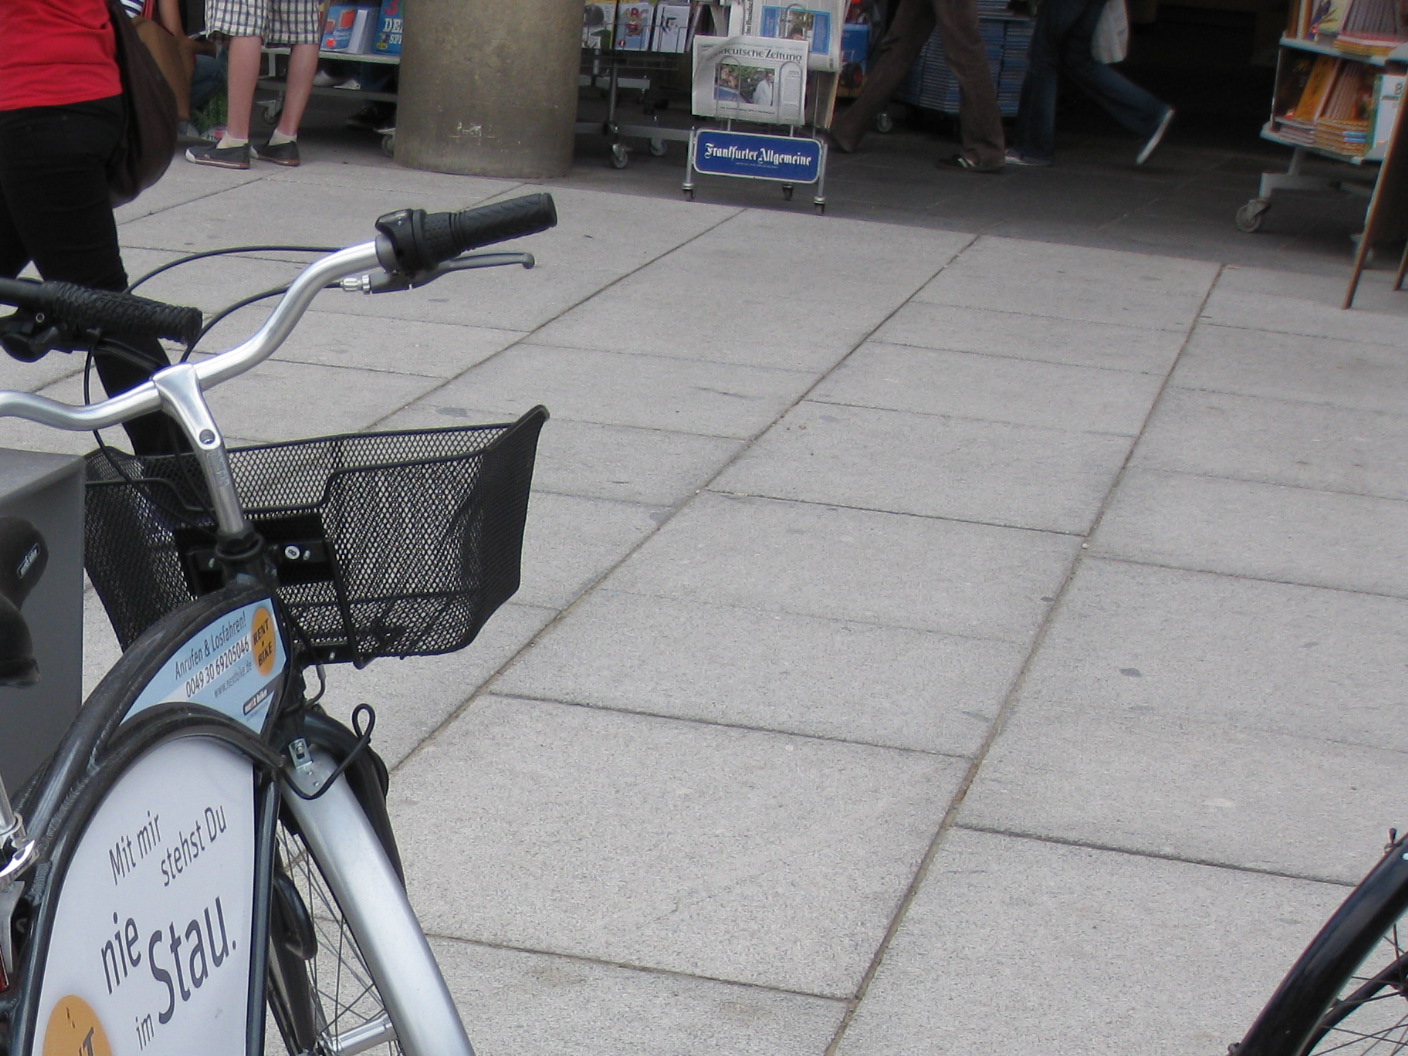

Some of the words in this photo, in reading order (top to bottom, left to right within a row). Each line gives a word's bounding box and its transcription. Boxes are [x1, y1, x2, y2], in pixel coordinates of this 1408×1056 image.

[765, 48, 803, 64] Zeitung
[704, 143, 758, 161] Frankfurter
[758, 147, 812, 166] Allgemeine
[175, 648, 203, 680] Anrufen
[204, 640, 211, 657] &
[211, 610, 247, 652] Losfahren!
[253, 618, 269, 646] RENT
[258, 642, 273, 667] BIKE
[185, 672, 204, 699] 0049
[204, 664, 215, 685] 30
[215, 635, 250, 676] 69205046
[109, 835, 136, 886] Mit
[137, 810, 161, 859] mir
[161, 820, 205, 887] stehst
[204, 805, 227, 843] Du
[101, 912, 141, 995] nie
[136, 1013, 155, 1051] im
[148, 896, 237, 1025] Stau.
